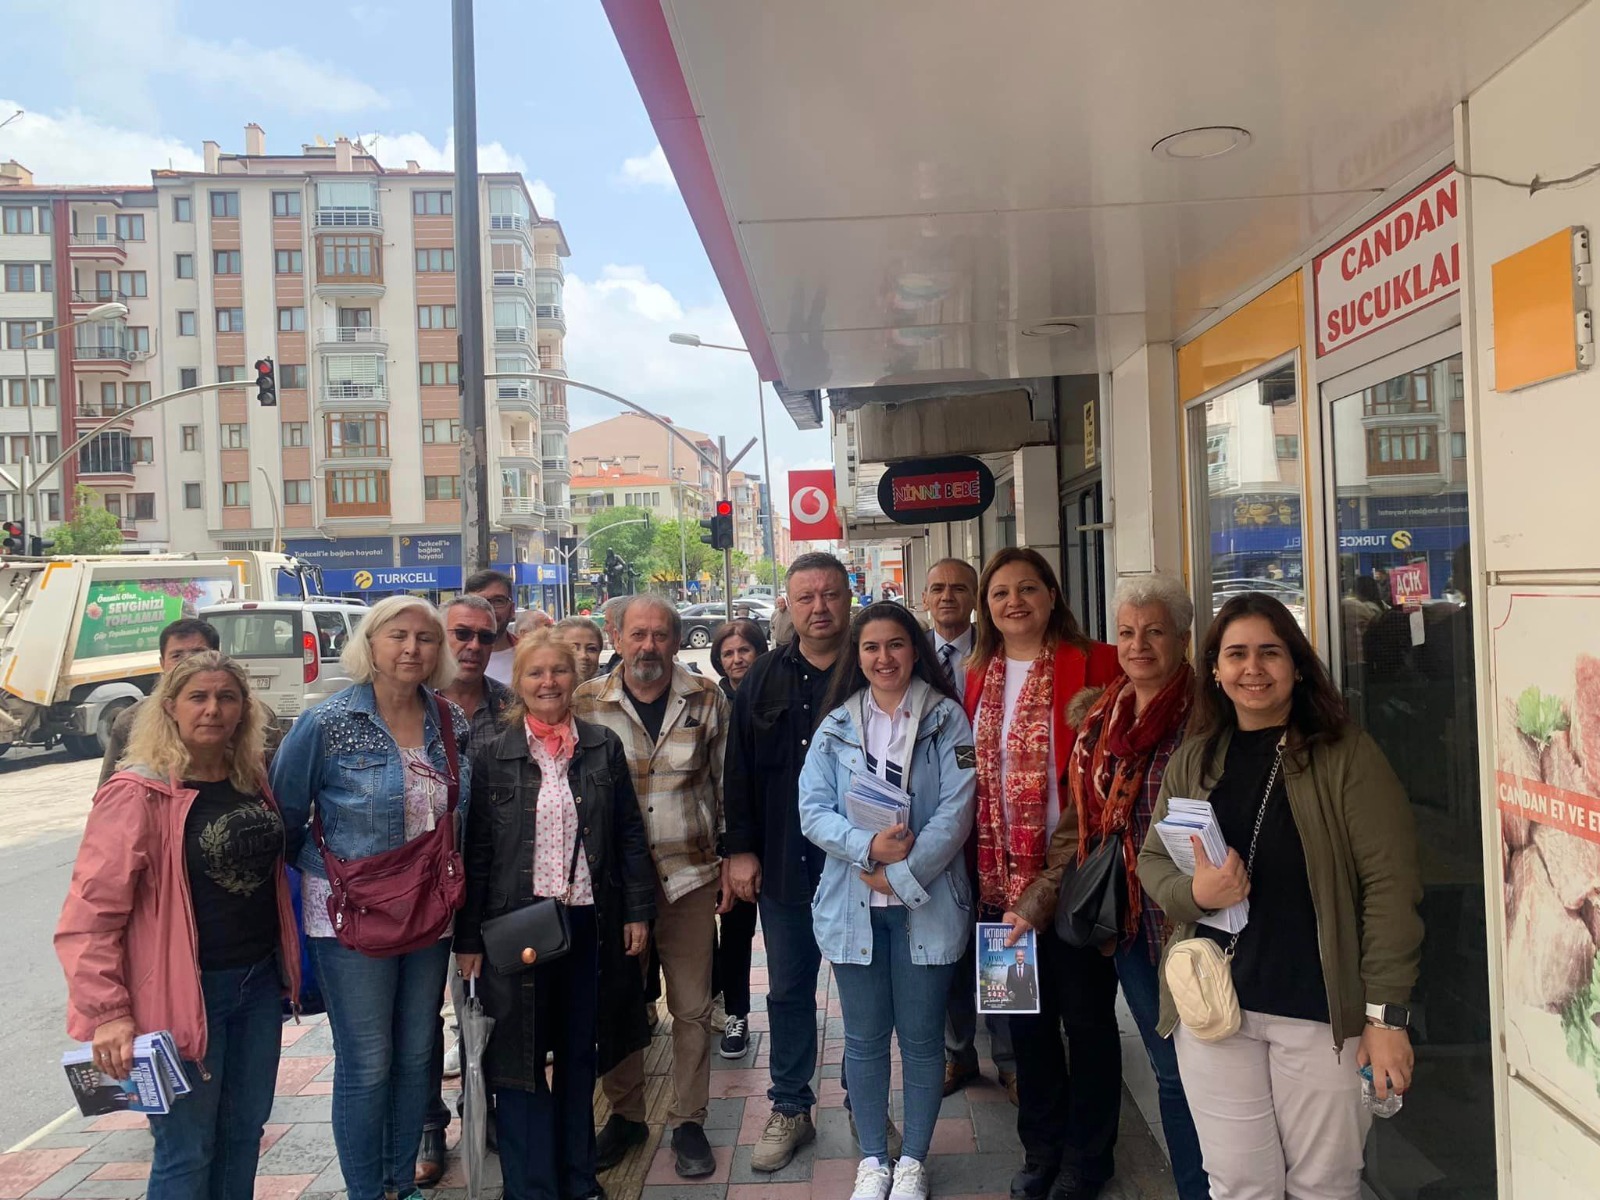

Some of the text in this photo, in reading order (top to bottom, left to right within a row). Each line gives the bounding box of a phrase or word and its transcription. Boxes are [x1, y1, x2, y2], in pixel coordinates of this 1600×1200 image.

[1341, 180, 1457, 281] CANDAN
[945, 480, 979, 498] BEBE
[330, 549, 355, 558] bağlan
[356, 548, 383, 558] hayata!
[377, 572, 437, 585] TURKCELL
[1396, 569, 1423, 595] AÇIK
[109, 596, 164, 614] SEVGİNİZİ
[106, 610, 166, 627] TOPLAMAK
[1500, 783, 1548, 815] CANDAN
[1551, 798, 1566, 821] ET
[1568, 803, 1586, 828] VE
